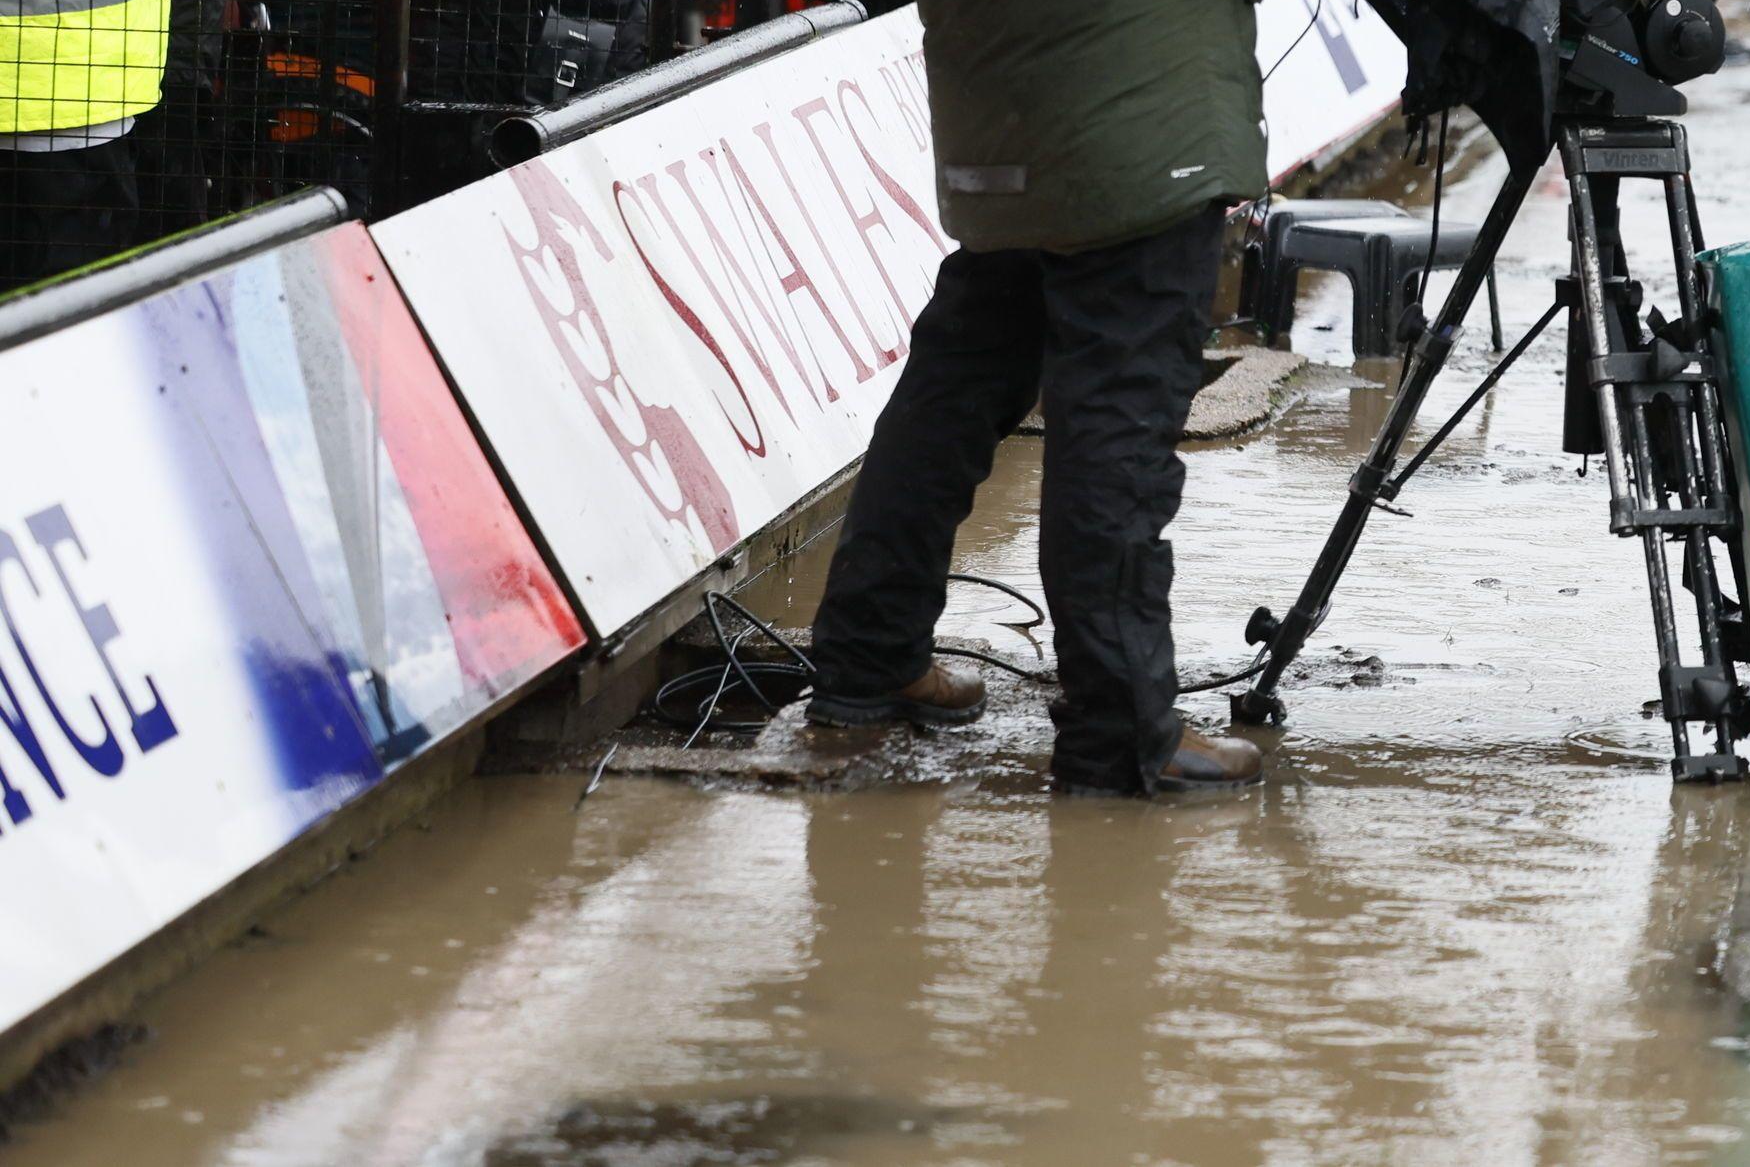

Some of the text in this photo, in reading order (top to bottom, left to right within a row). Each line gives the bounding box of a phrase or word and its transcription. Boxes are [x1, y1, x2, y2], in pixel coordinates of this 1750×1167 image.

[1617, 50, 1639, 65] 750
[1603, 152, 1659, 169] Vinten
[613, 48, 950, 458] SWALES BU
